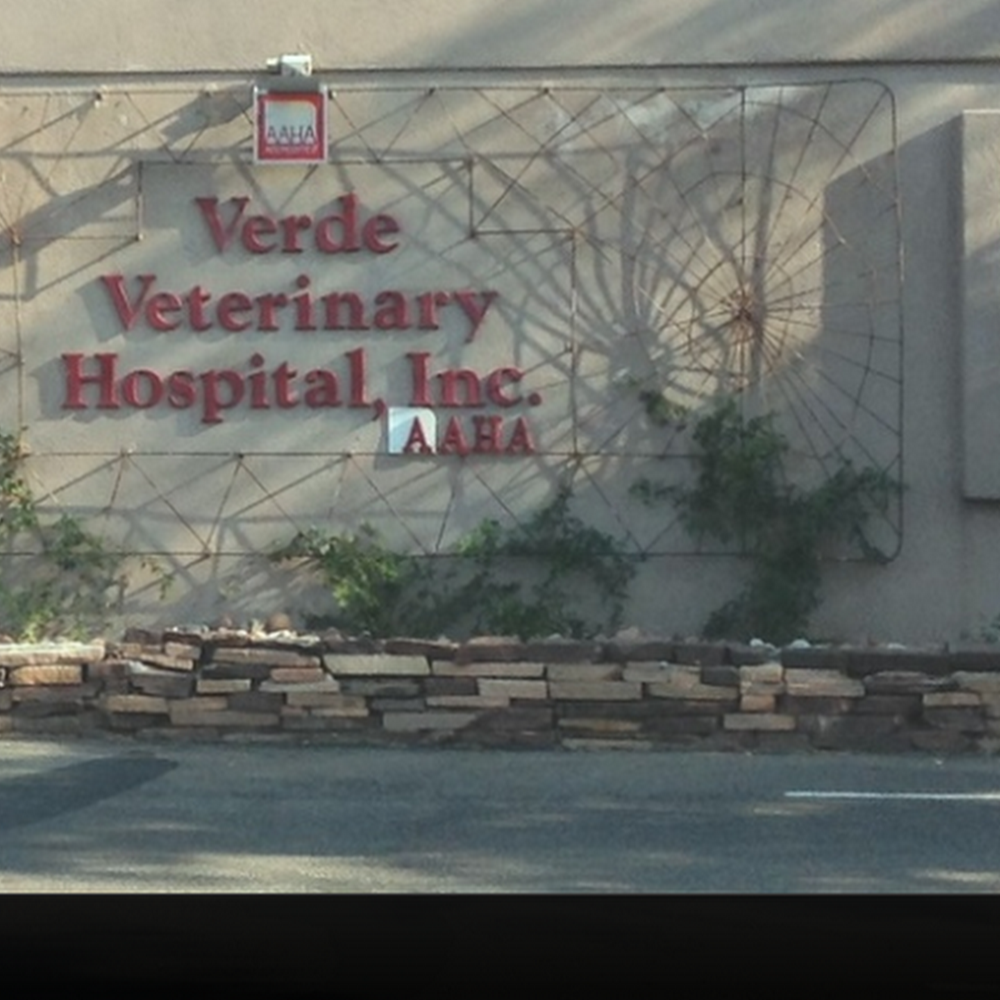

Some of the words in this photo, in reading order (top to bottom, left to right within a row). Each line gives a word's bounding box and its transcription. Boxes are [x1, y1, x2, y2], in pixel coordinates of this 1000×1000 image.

[266, 126, 316, 146] AAHA
[194, 192, 400, 254] Verde
[101, 274, 499, 344] Veterinary
[61, 347, 388, 425] Hospital,
[405, 351, 543, 410] Inc.
[402, 415, 537, 456] AAHA
